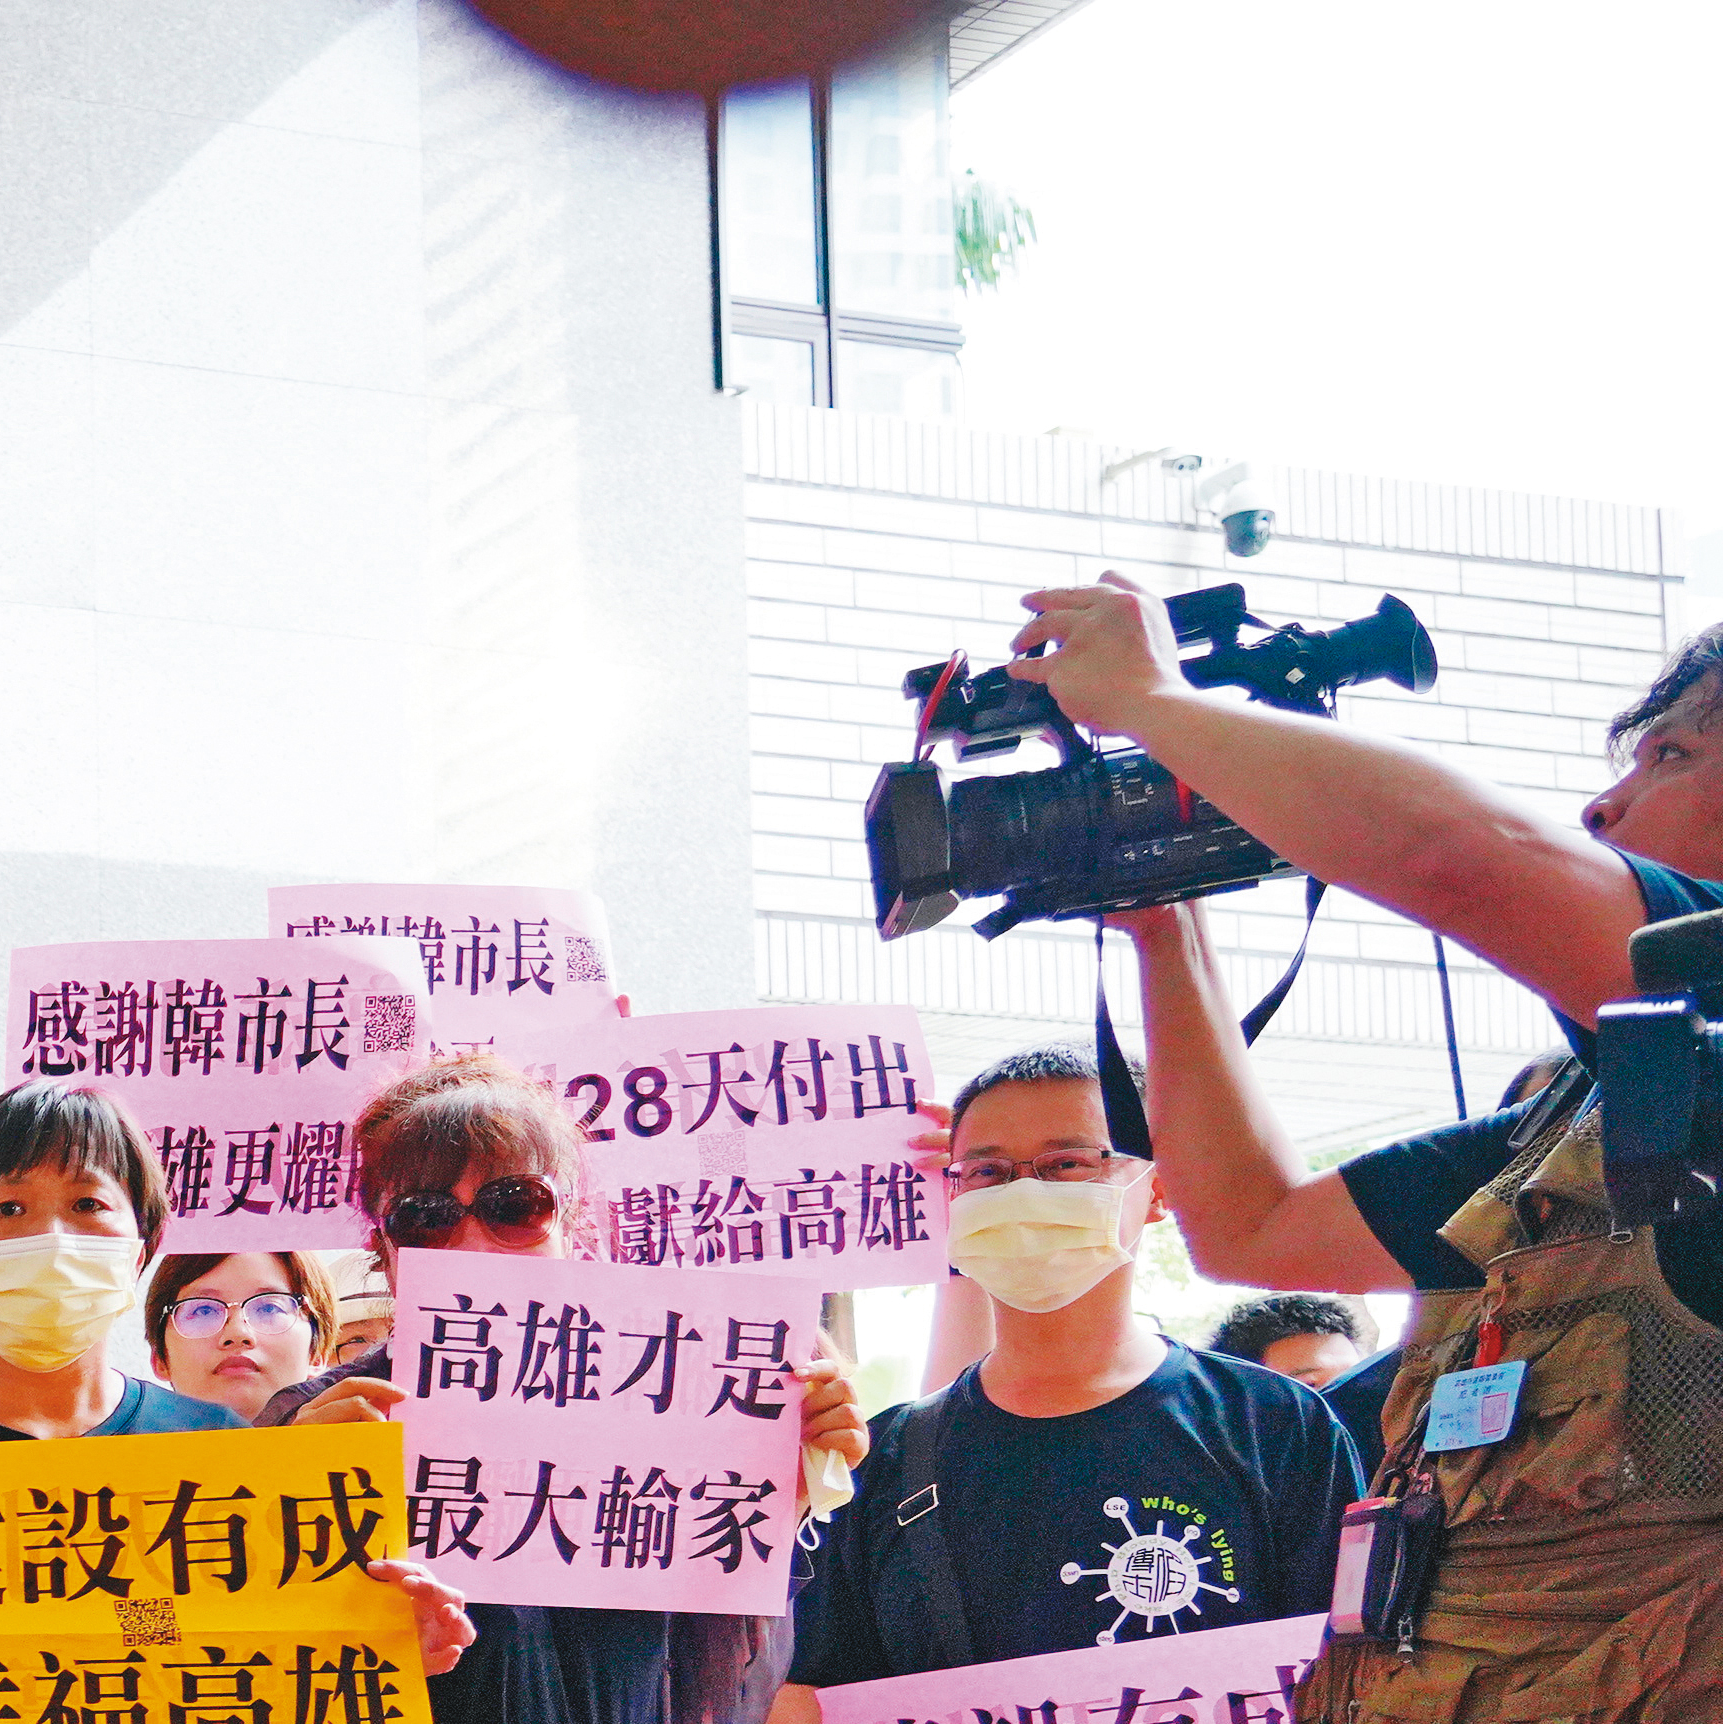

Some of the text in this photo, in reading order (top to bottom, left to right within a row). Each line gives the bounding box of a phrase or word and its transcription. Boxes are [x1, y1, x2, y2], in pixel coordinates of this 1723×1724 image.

[286, 915, 556, 997] 韓市長
[21, 974, 351, 1077] 感謝韓市長
[156, 1120, 359, 1219] 雄更耀
[416, 1294, 796, 1421] 高雄才是
[406, 1454, 777, 1574] 最大輸家
[1141, 1496, 1208, 1525] who's
[1210, 1528, 1236, 1582] lying
